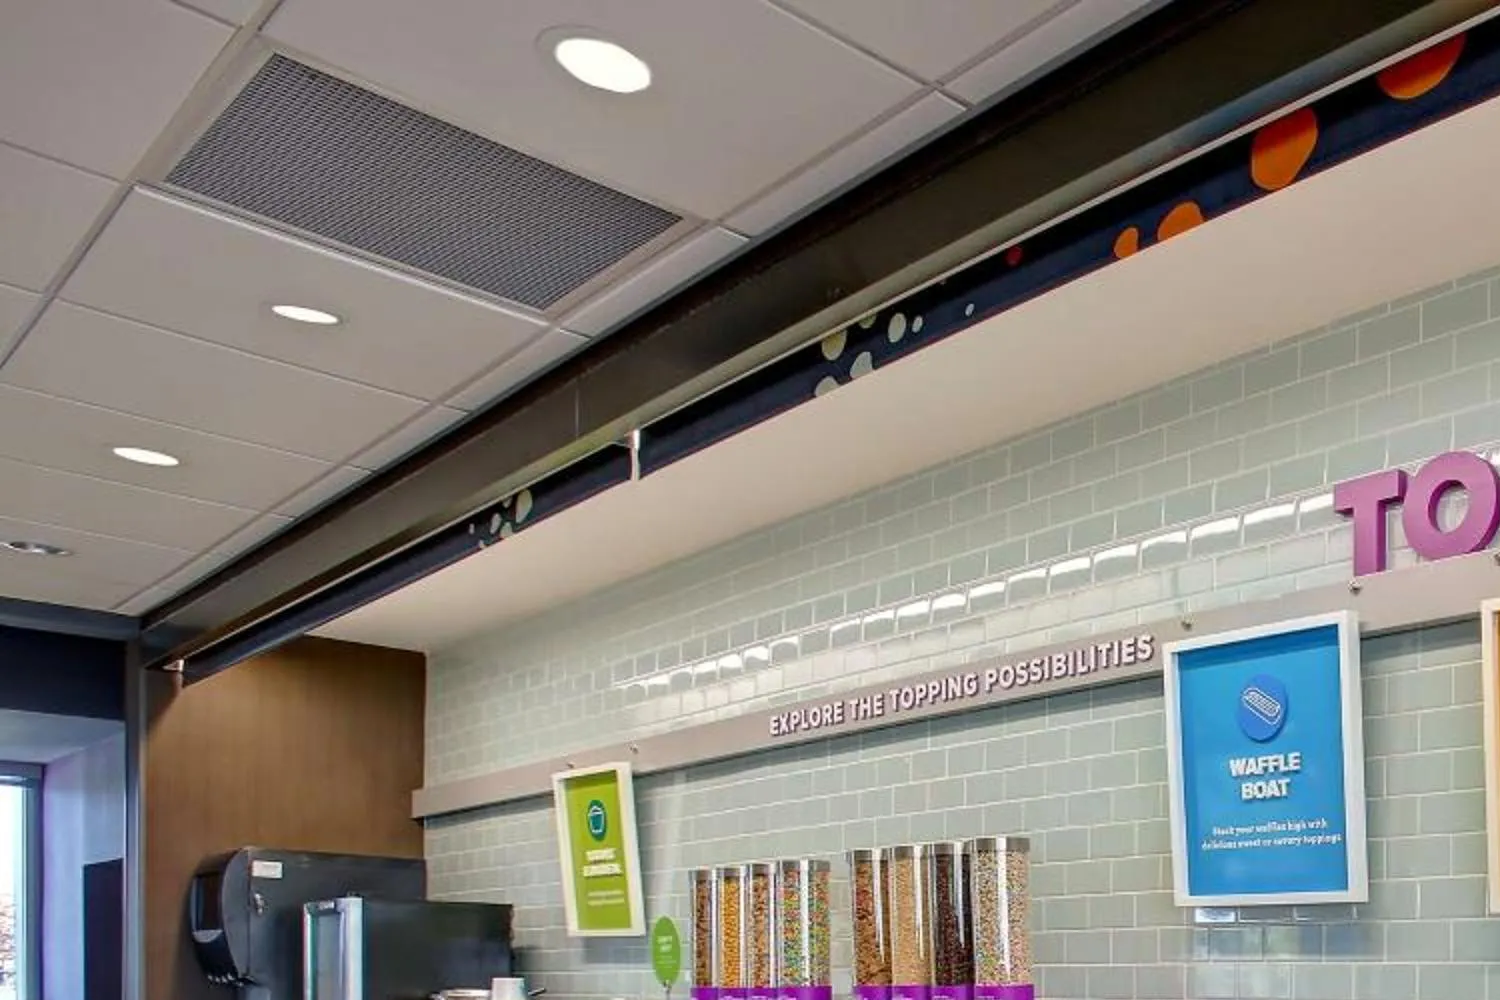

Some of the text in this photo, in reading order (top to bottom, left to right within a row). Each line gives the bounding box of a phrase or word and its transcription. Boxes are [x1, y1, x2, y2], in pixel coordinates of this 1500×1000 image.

[770, 634, 1154, 736] EXPLORE THE TOPPING POSSIBILITIES
[1229, 752, 1302, 777] WAFFLE
[1241, 778, 1290, 800] BOAT
